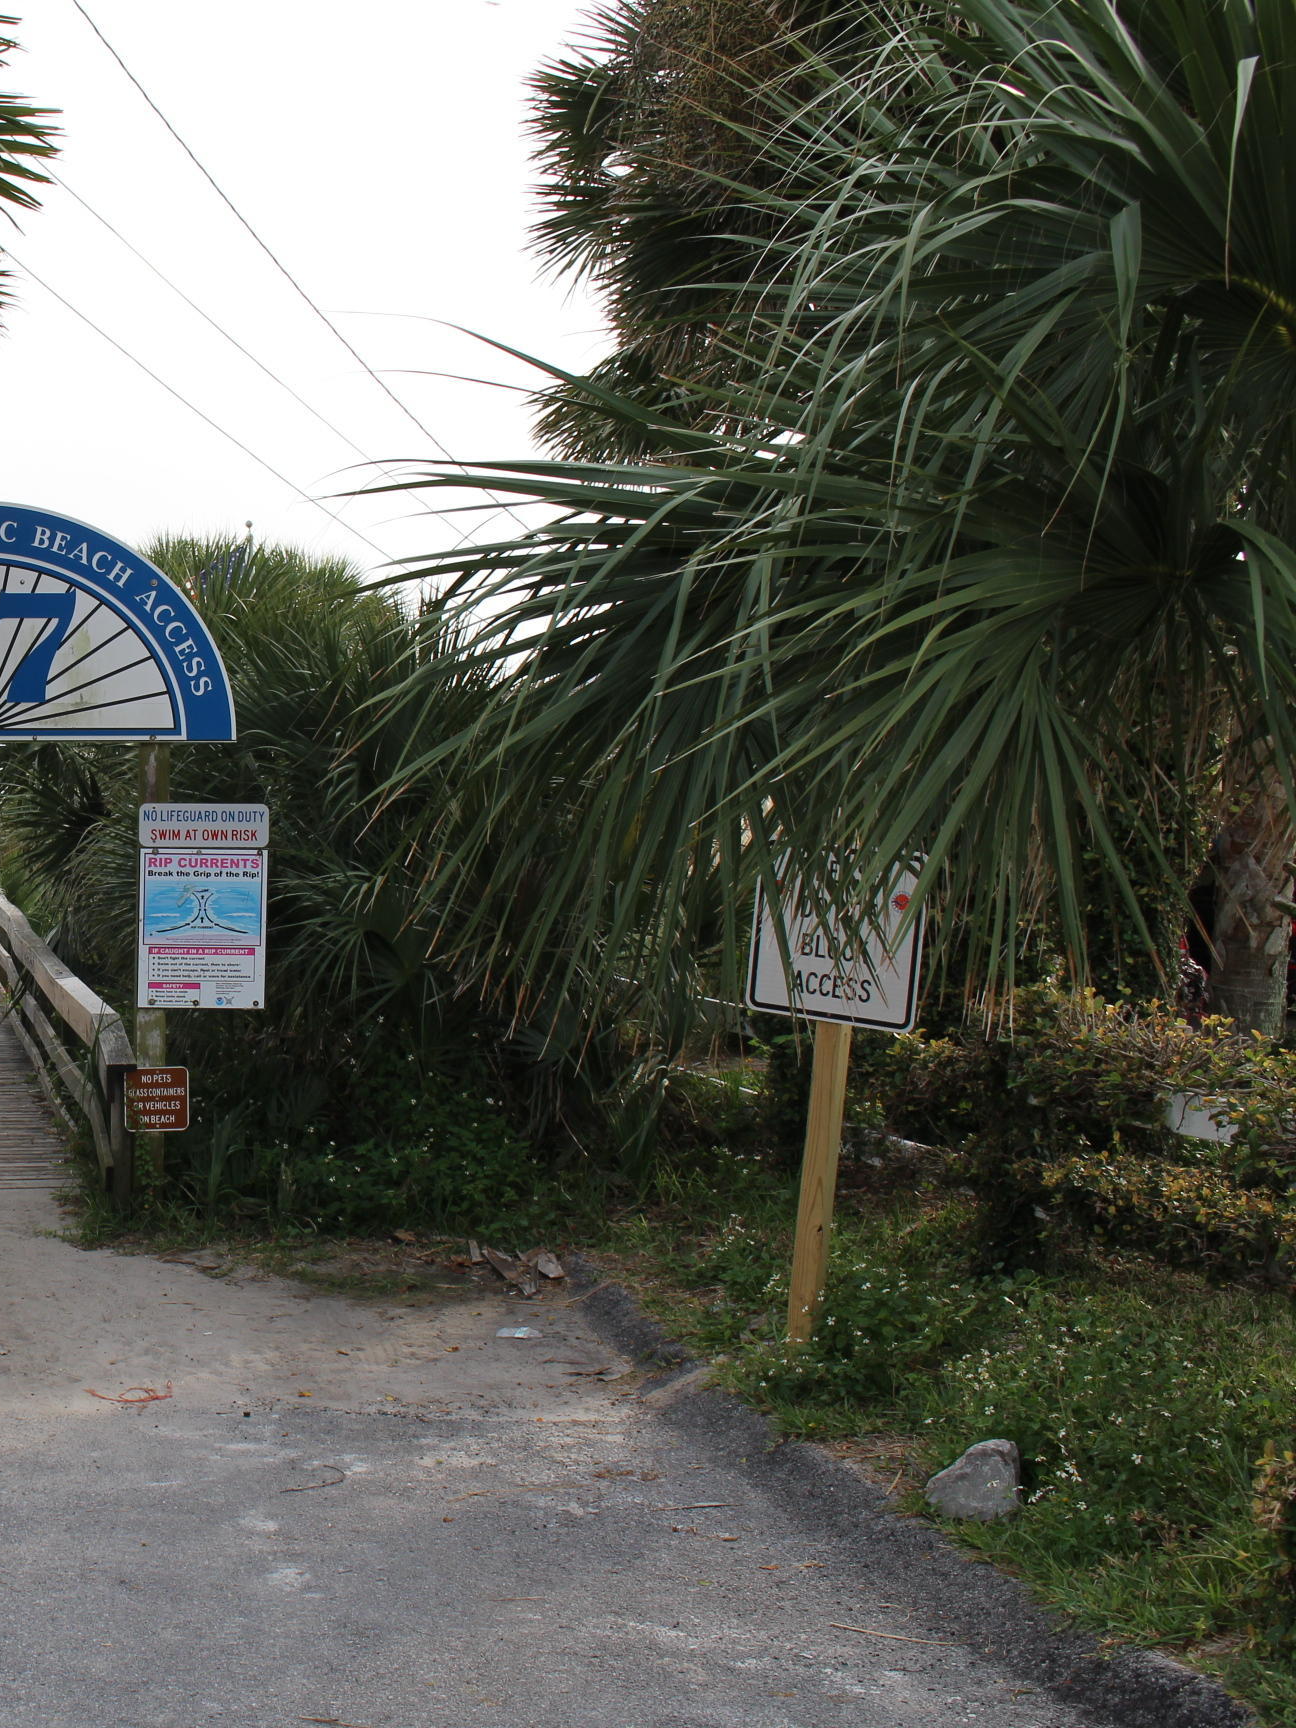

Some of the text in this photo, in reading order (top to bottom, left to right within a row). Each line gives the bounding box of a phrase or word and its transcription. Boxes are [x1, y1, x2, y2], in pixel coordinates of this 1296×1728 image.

[32, 526, 134, 589] BEACH
[135, 588, 214, 697] ACCESS
[143, 809, 265, 822] NO LIFEGUARD ON DUTY
[150, 829, 258, 841] SWIM AT OWN RISK
[148, 857, 260, 869] RIP CURRENTS
[193, 870, 212, 879] Grip
[242, 871, 260, 879] Rip!
[794, 969, 872, 1003] ACCESS
[141, 1074, 172, 1084] NO PETS
[149, 1087, 185, 1096] CONTAINERS
[145, 1100, 181, 1110] VEHICLES
[150, 1114, 175, 1124] BEACH
